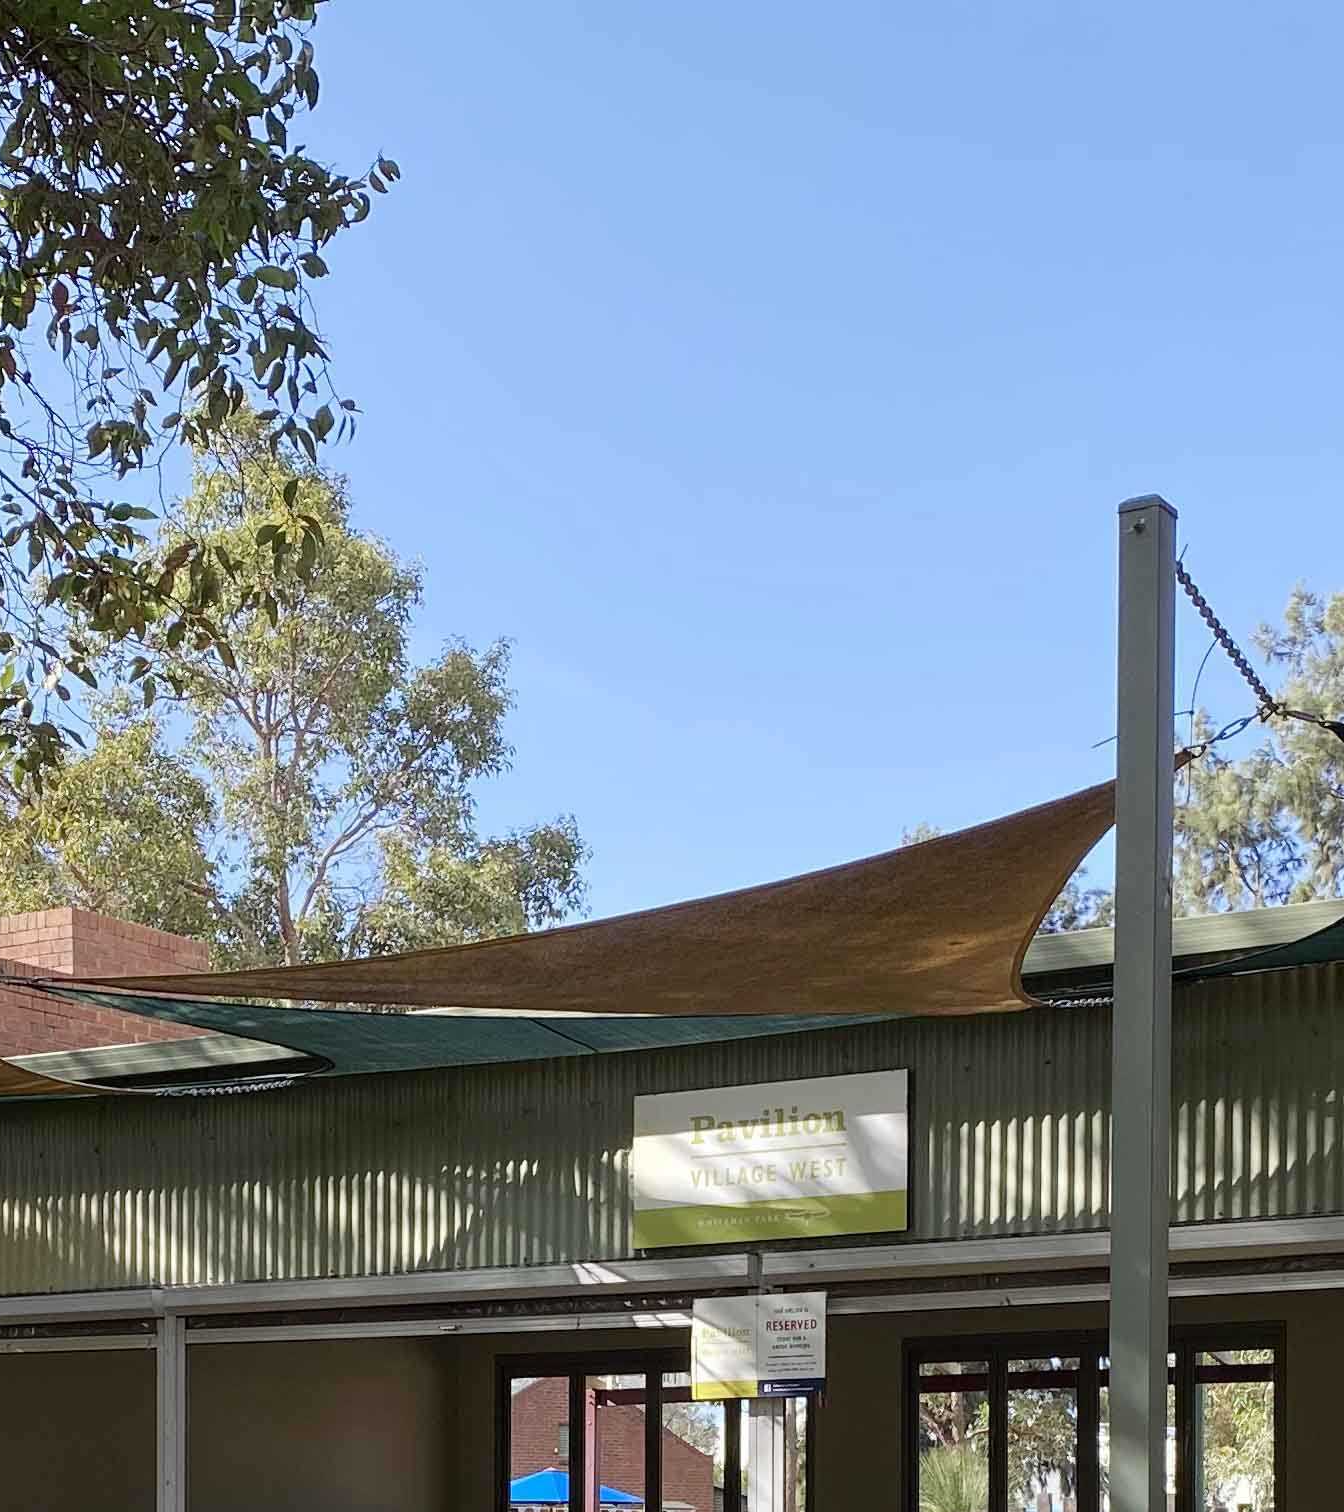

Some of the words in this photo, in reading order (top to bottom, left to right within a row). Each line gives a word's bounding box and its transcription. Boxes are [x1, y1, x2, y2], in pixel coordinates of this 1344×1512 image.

[690, 1106, 846, 1144] Pavilion
[690, 1164, 777, 1186] VILLAGE
[789, 1158, 846, 1183] WEST
[766, 1319, 817, 1332] RESERVED
